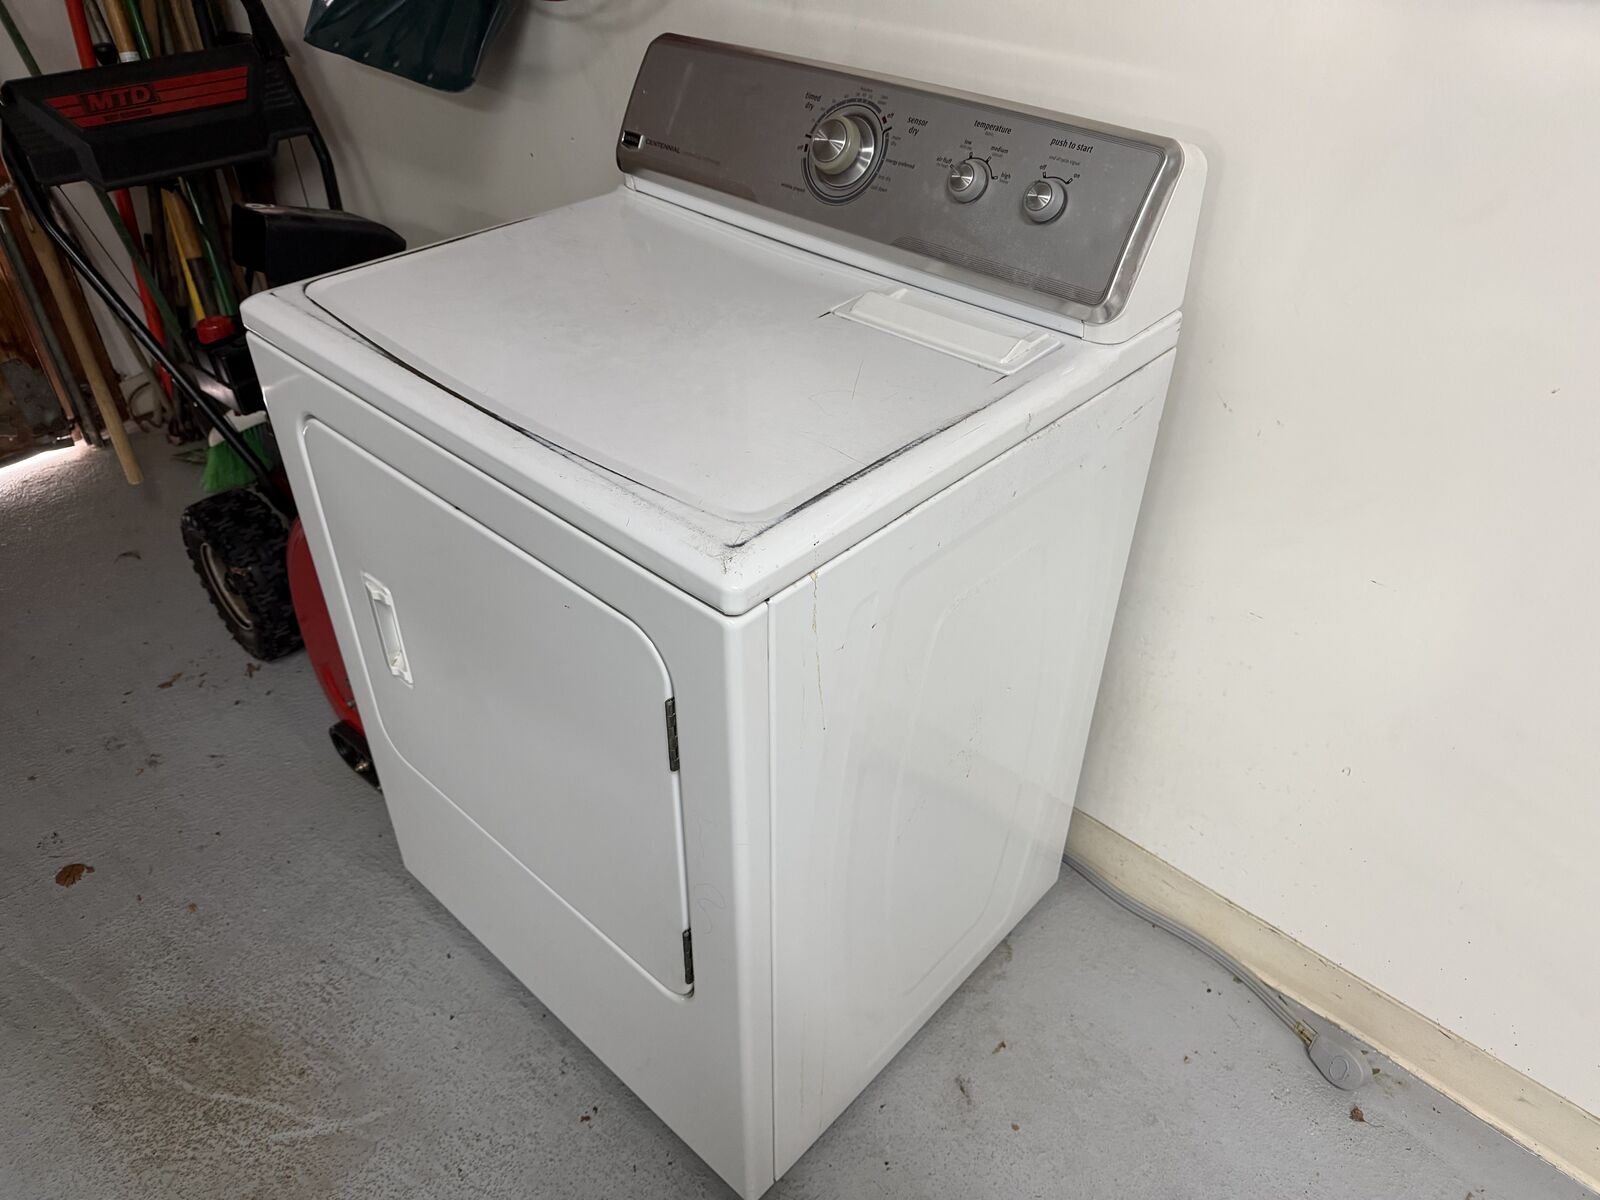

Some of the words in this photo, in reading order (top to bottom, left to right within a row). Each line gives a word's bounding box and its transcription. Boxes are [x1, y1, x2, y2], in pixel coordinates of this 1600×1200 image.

[87, 85, 152, 111] MTD
[805, 91, 822, 102] timed
[805, 101, 815, 111] dry
[906, 115, 929, 127] sensor
[973, 119, 1012, 135] temperature
[907, 126, 920, 136] dry
[645, 137, 680, 154] CENTENNIAL
[1049, 137, 1069, 150] push
[1068, 141, 1077, 150] to
[1076, 143, 1094, 153] start
